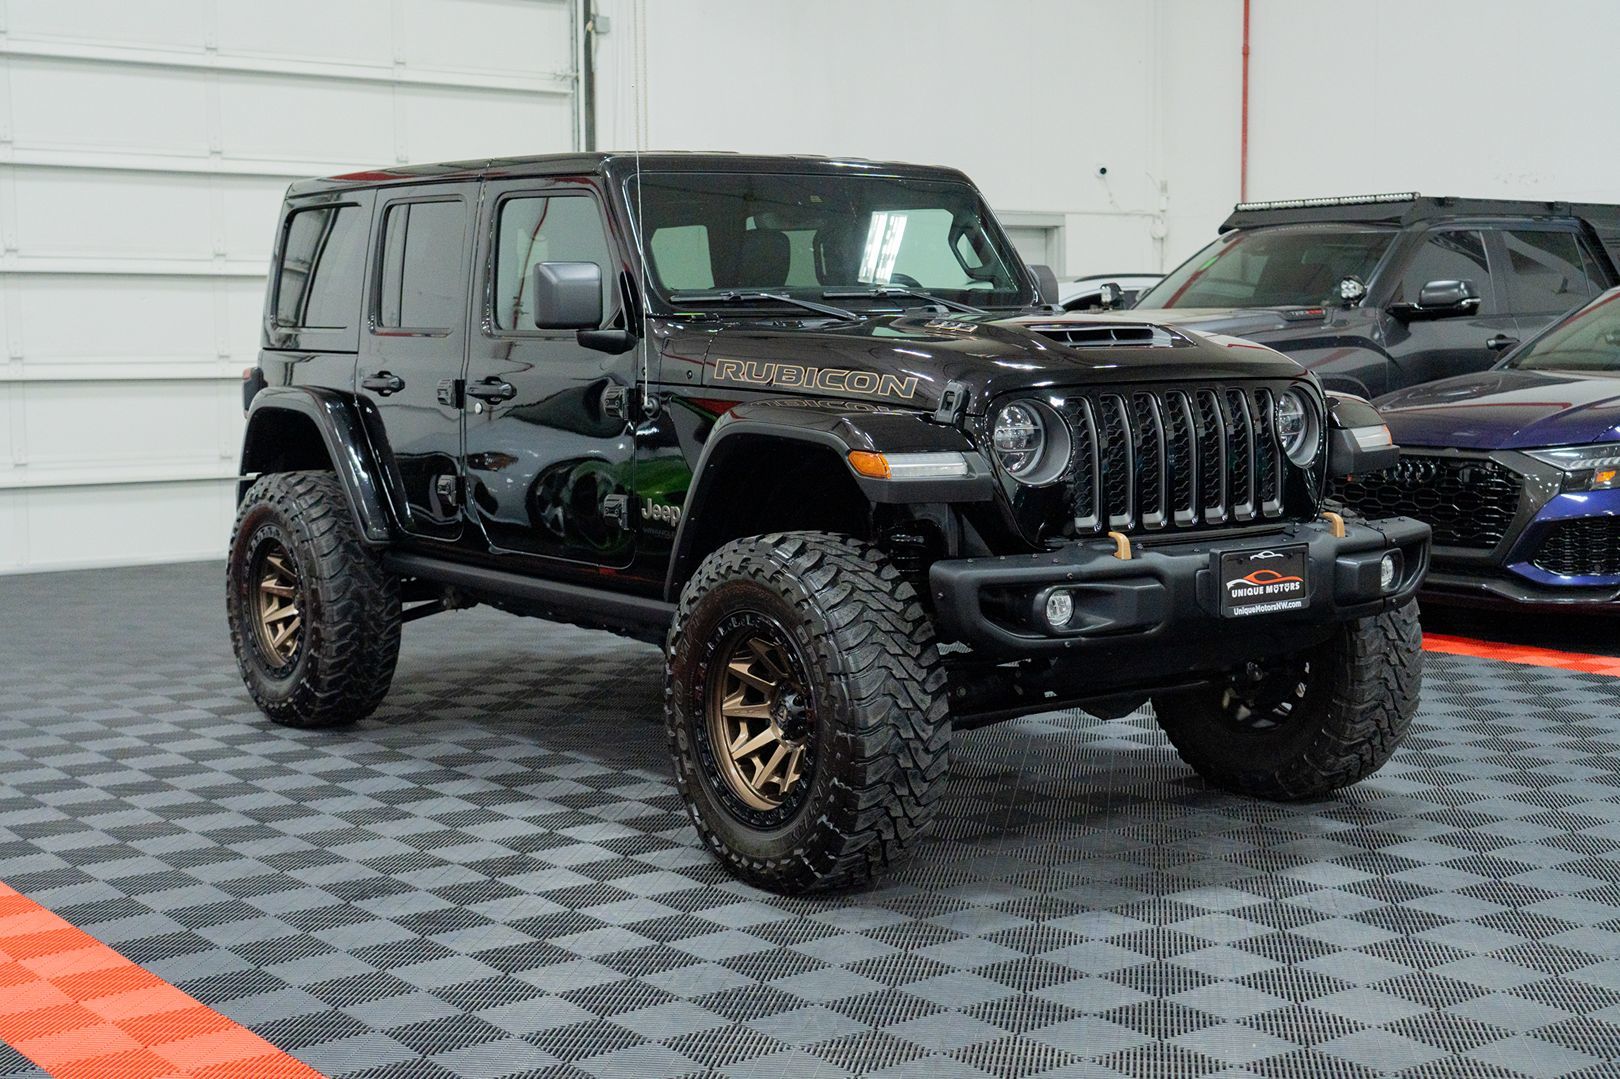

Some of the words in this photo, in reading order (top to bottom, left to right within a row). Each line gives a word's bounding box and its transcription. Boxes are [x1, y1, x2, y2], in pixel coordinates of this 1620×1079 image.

[714, 358, 918, 399] RUBICON
[641, 497, 681, 527] Jeep
[1231, 586, 1264, 598] UNIQUE
[1265, 582, 1300, 594] MOTORS
[1233, 600, 1302, 616] UniqueMotorsNW.com
[674, 679, 693, 775] TOYO
